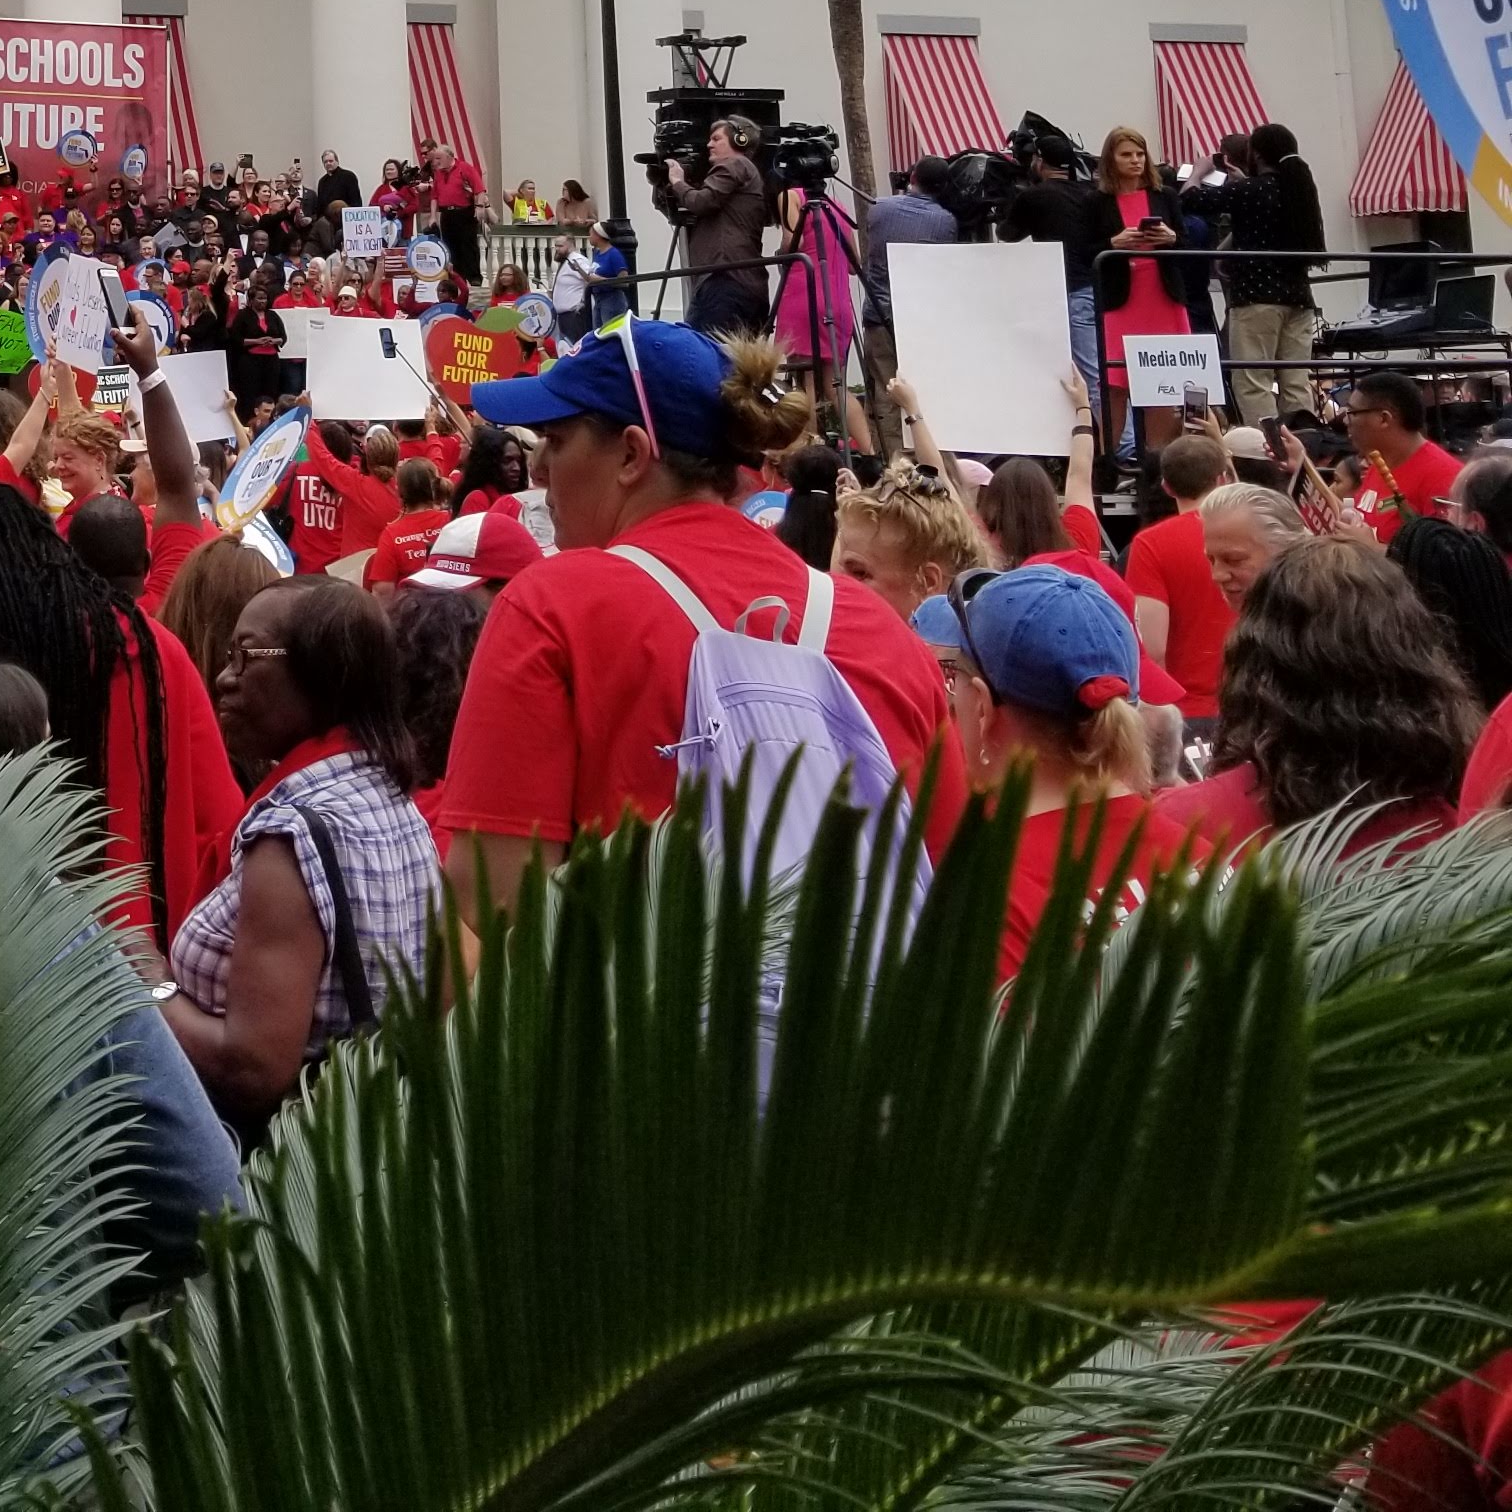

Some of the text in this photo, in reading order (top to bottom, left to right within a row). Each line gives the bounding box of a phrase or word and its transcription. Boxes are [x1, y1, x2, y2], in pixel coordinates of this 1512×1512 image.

[345, 211, 379, 222] EDUCATION
[355, 223, 372, 235] IS A
[346, 238, 382, 251] CIVIL RIGHT
[40, 280, 61, 314] FUND
[47, 302, 61, 332] OUR
[454, 332, 493, 353] FUND
[457, 350, 487, 369] OUR
[1138, 350, 1207, 369] Media Only
[105, 374, 129, 385] SCHOO
[103, 389, 129, 404] FUTU
[1158, 385, 1175, 394] FEA
[252, 458, 273, 479] OUR
[303, 502, 337, 530] UTO
[395, 532, 426, 544] Orange
